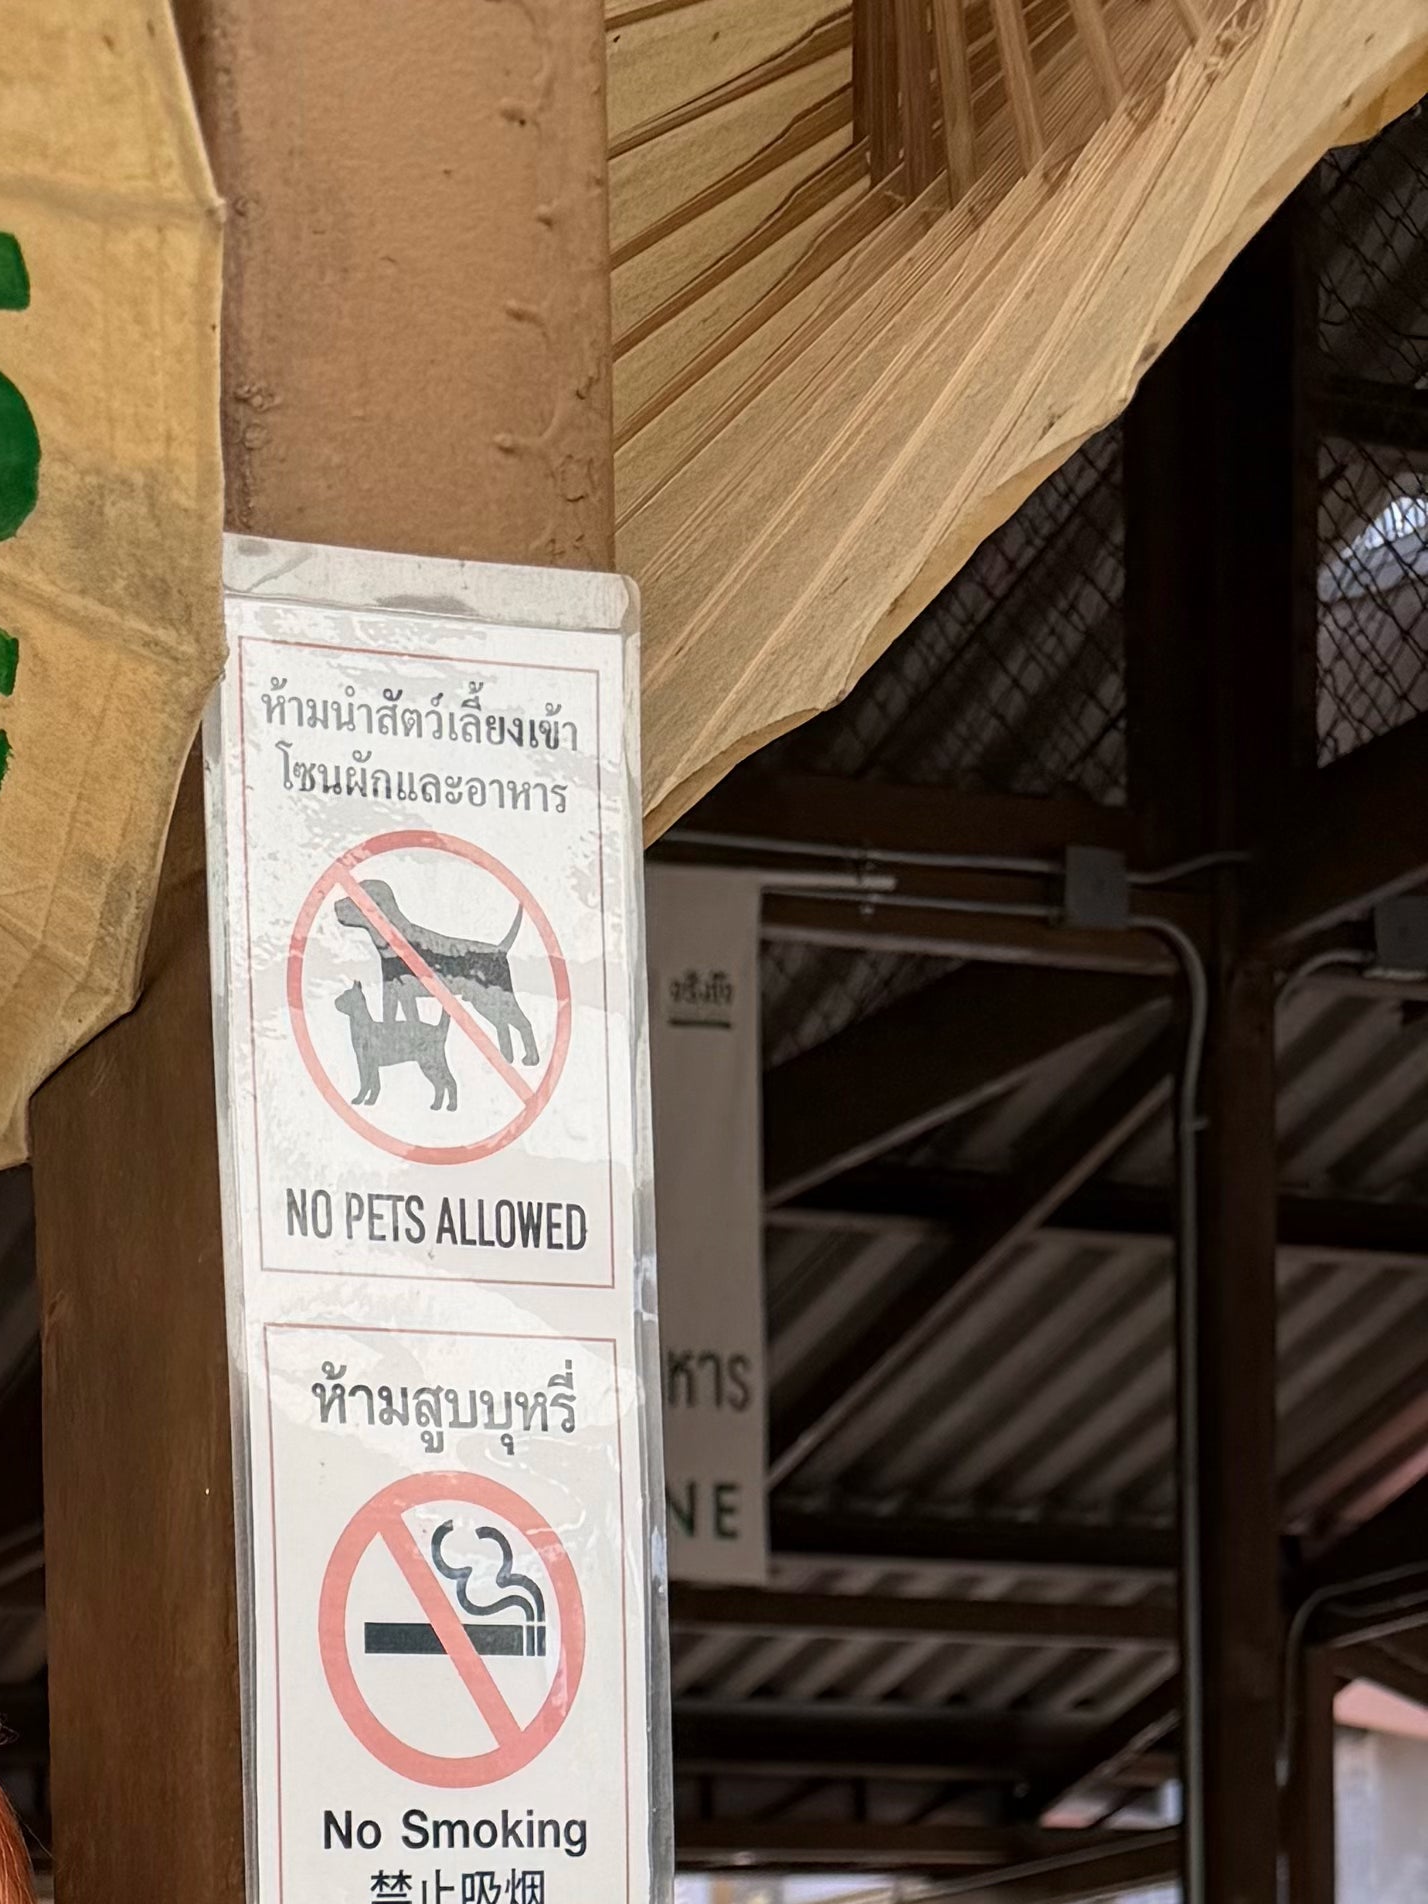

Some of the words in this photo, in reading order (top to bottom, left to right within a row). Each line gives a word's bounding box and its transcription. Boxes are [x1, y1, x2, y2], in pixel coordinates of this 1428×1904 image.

[260, 676, 579, 751] ห้ามนำสัตว์เลี้ยงเข้า
[274, 740, 569, 813] โซนผักและอาหาร
[286, 1187, 331, 1239] NO
[346, 1192, 425, 1245] PETS
[436, 1196, 587, 1251] ALLOWED
[311, 1360, 576, 1455] ห้ามสูบบุหรี่
[324, 1809, 381, 1850] No
[401, 1808, 588, 1857] Smoking
